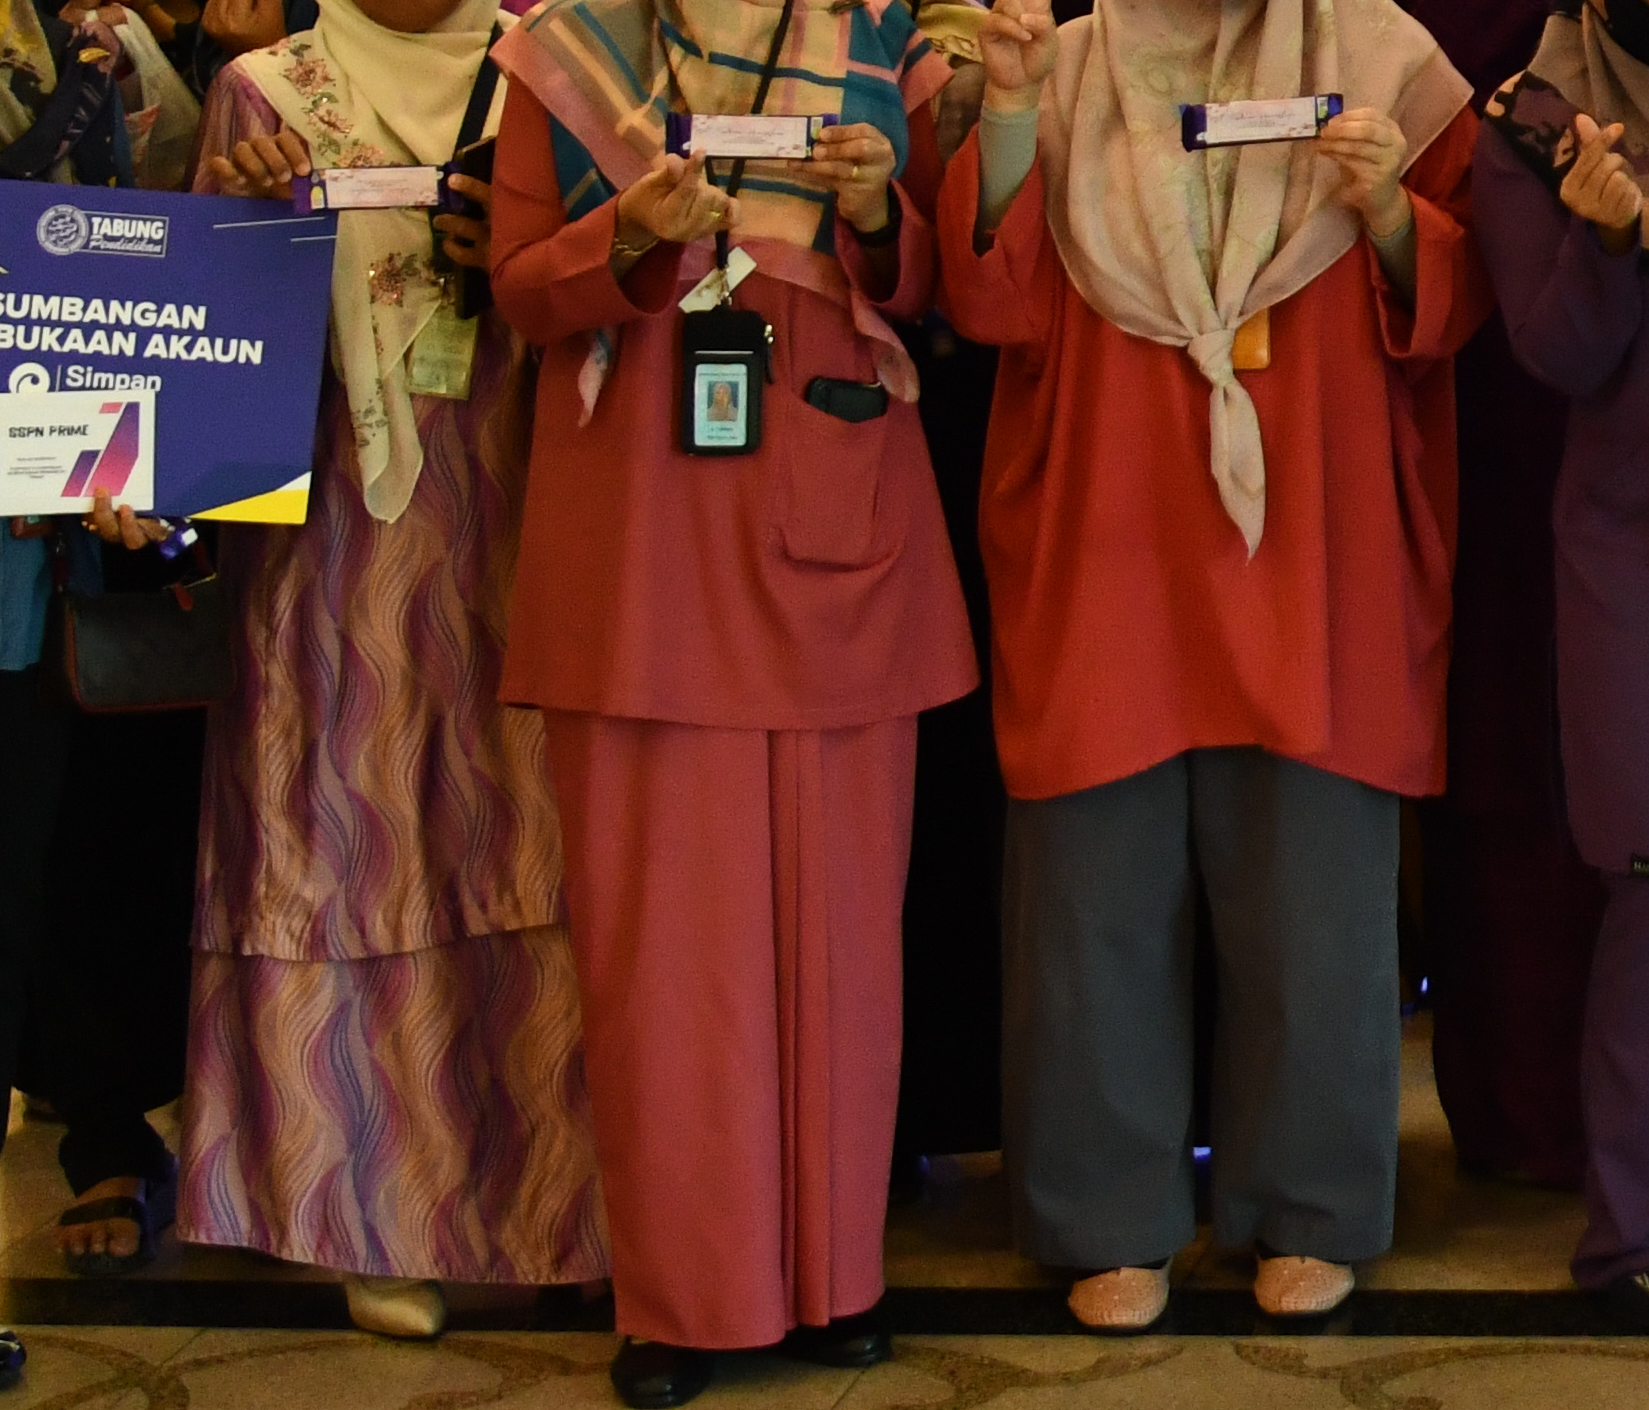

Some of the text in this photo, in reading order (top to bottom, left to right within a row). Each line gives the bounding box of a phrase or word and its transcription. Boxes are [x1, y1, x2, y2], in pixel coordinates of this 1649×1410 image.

[91, 216, 165, 241] TABUNG
[143, 332, 264, 366] AKAUN
[65, 364, 162, 392] Simpan
[49, 424, 89, 437] PRIME
